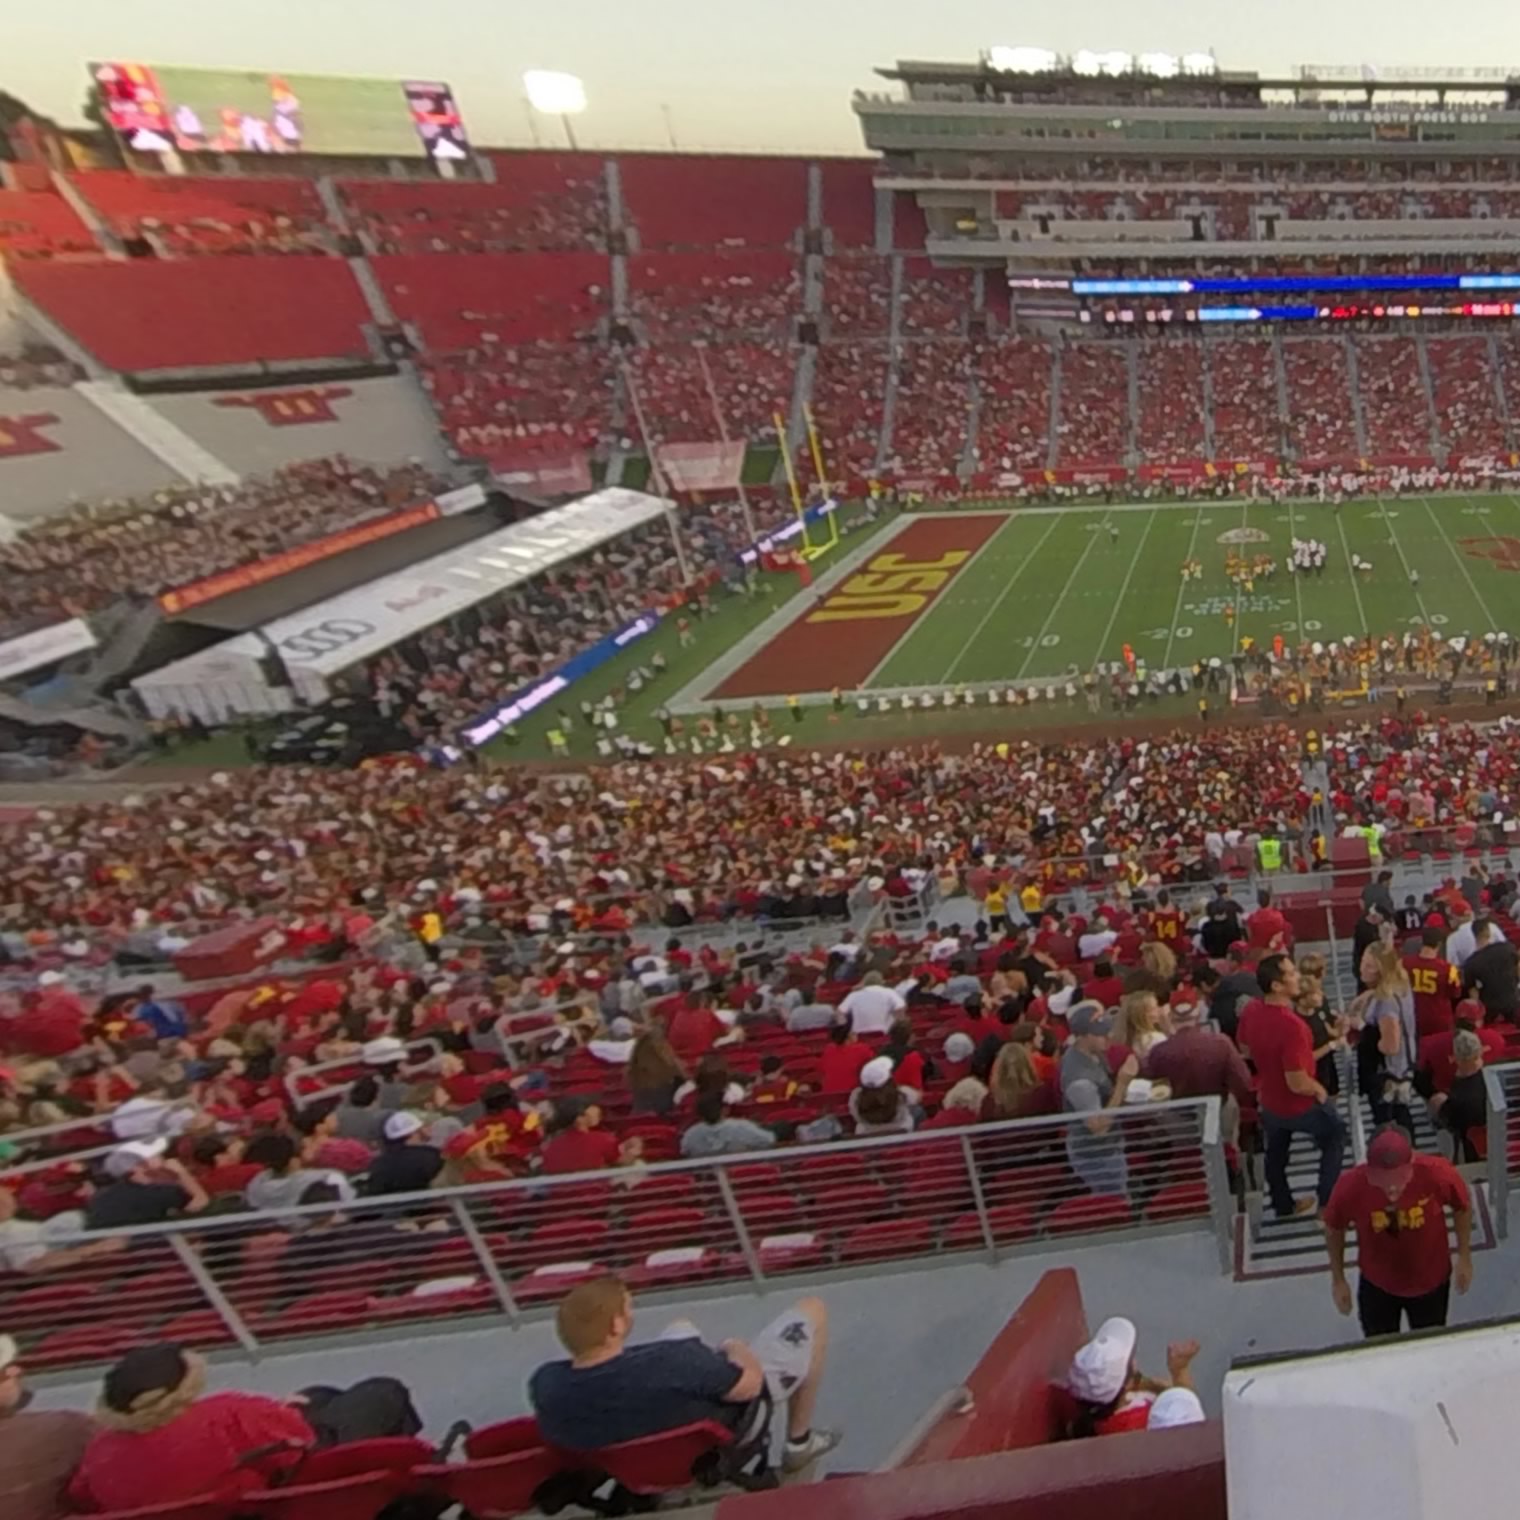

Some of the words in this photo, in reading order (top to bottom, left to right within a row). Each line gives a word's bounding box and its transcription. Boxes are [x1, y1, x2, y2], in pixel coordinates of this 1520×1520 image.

[1328, 111, 1359, 124] OTIS
[805, 550, 971, 623] USC
[1155, 919, 1177, 938] 14
[1412, 967, 1438, 995] 15
